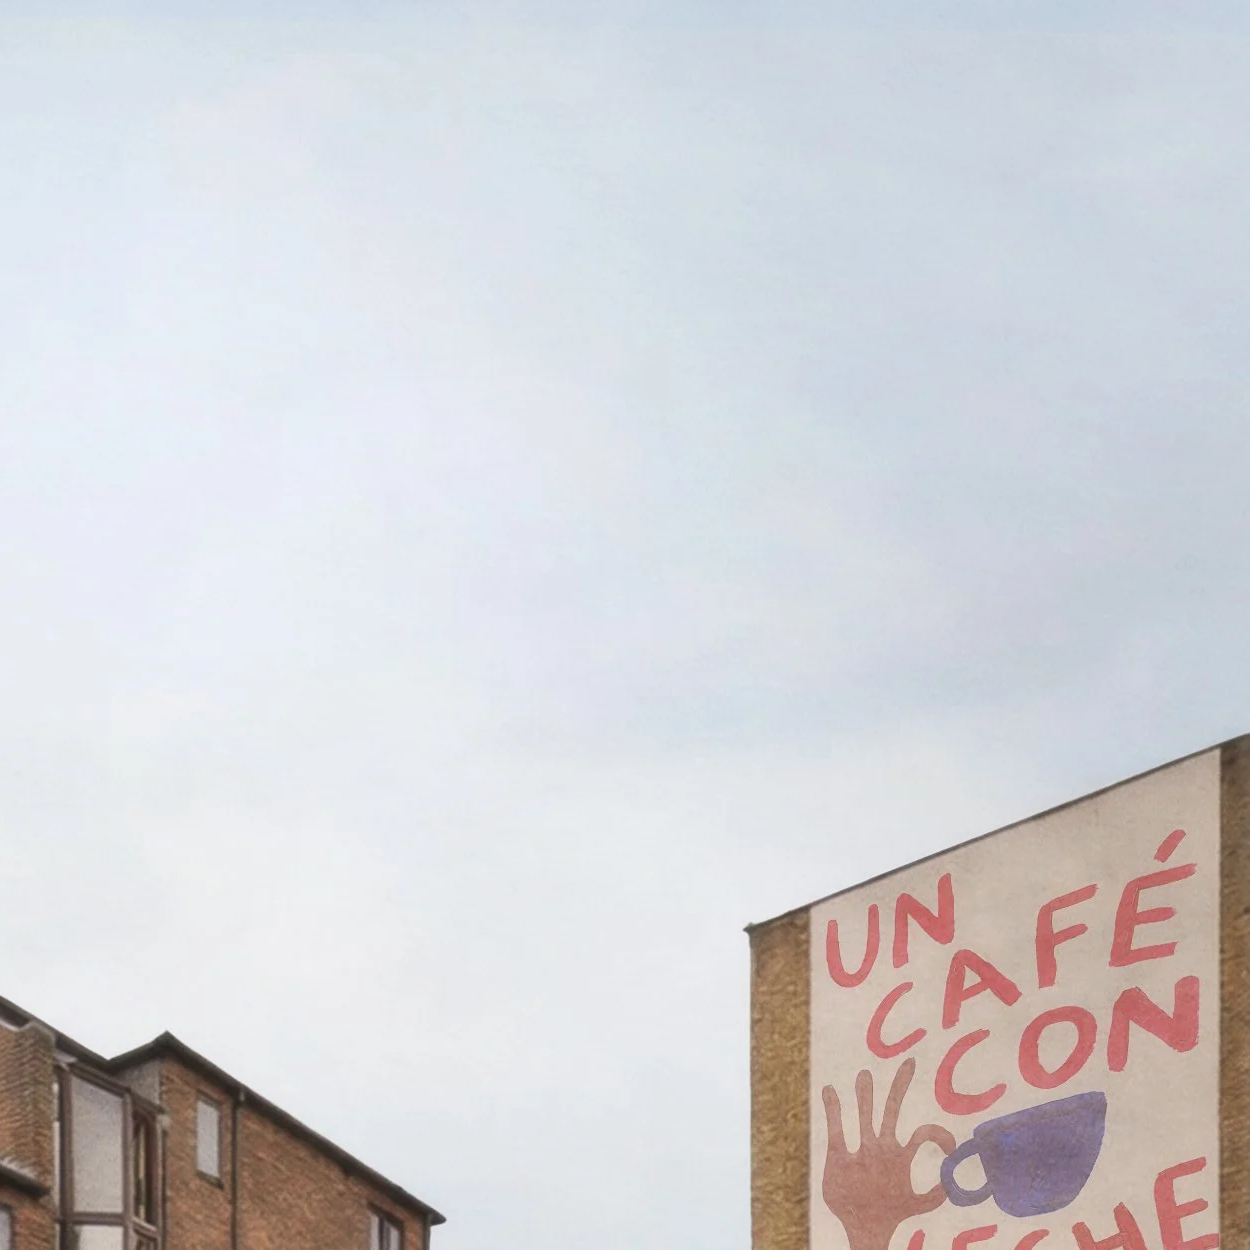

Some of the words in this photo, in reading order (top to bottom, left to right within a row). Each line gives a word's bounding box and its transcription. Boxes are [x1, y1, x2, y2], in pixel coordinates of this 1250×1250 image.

[825, 873, 955, 988] UN
[866, 829, 1198, 1060] CAFÉ
[934, 975, 1200, 1116] CON
